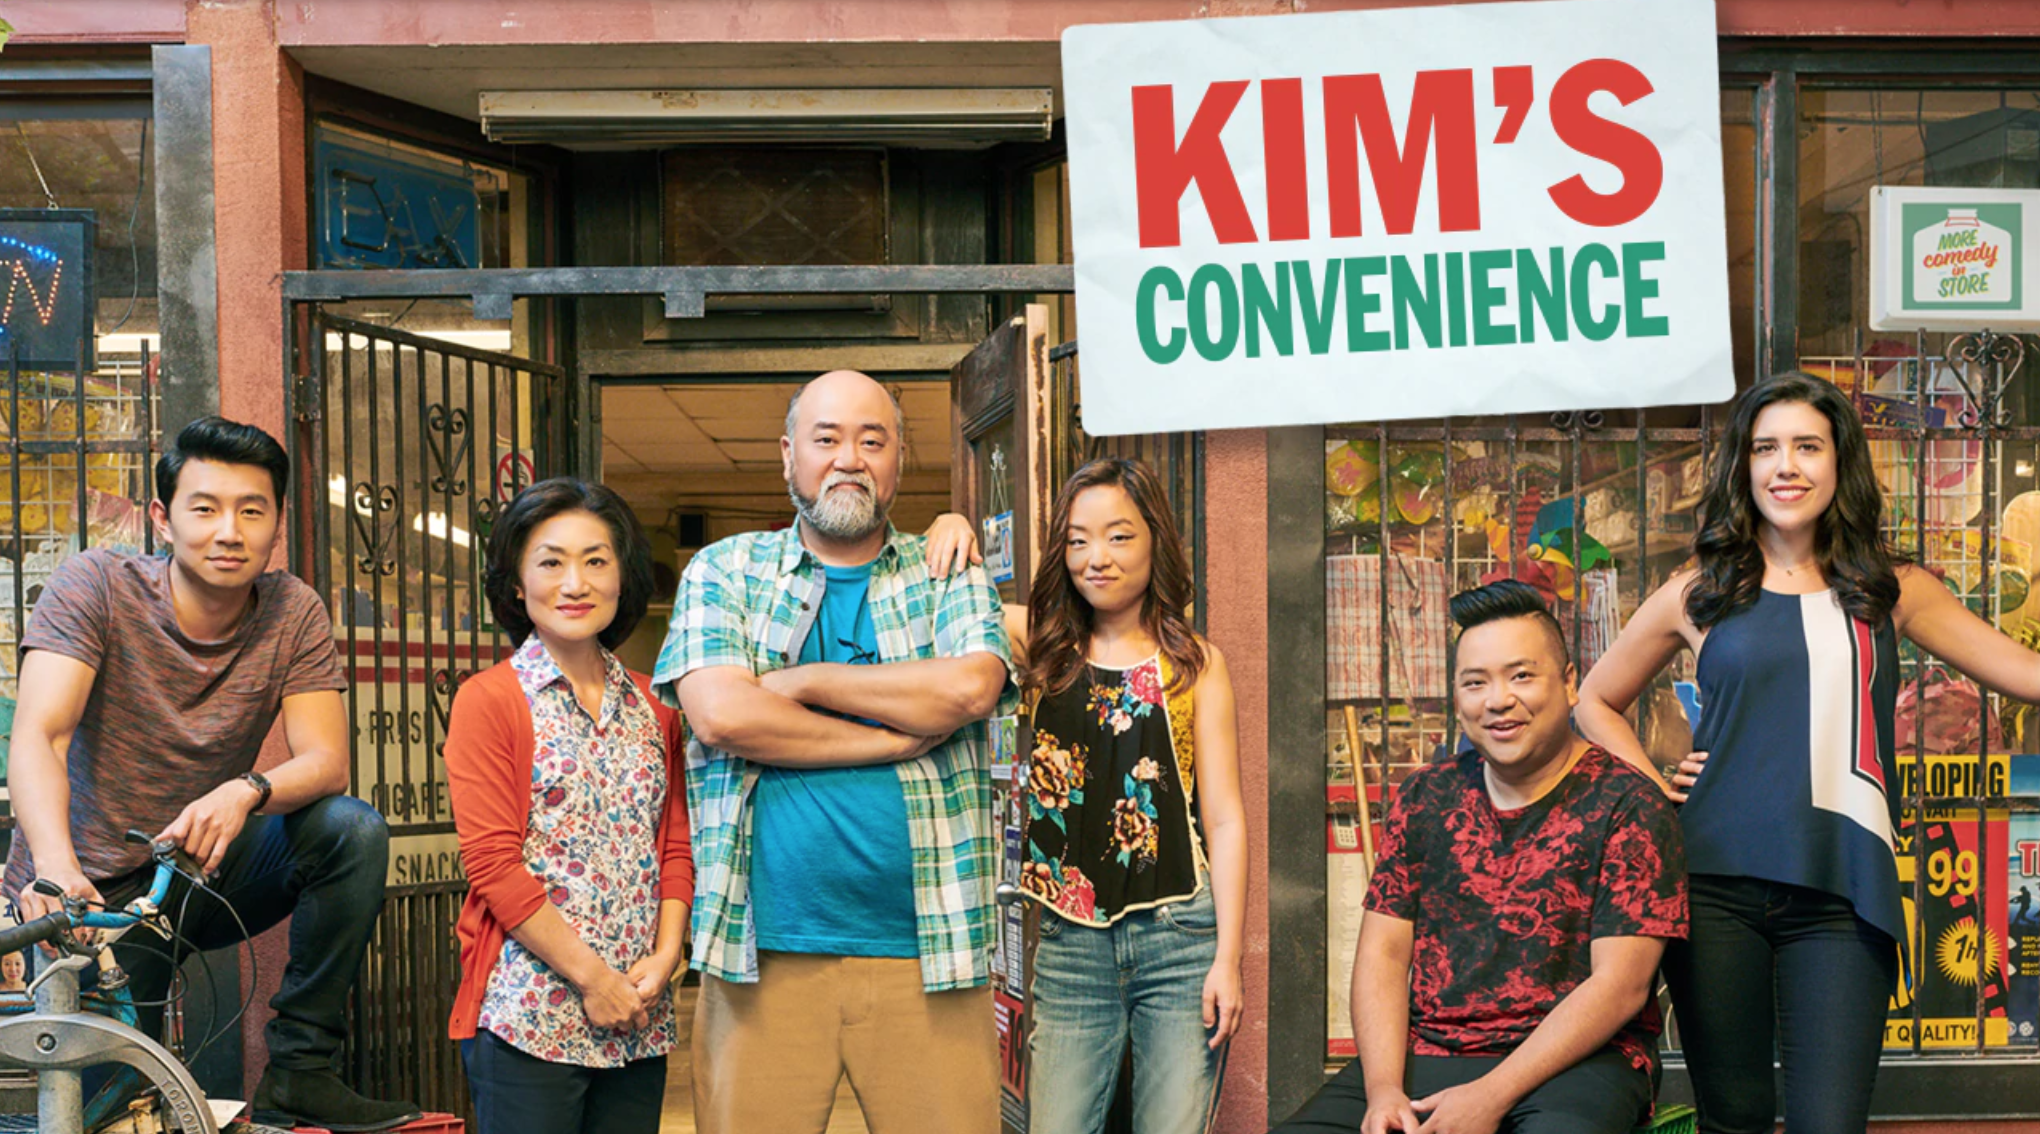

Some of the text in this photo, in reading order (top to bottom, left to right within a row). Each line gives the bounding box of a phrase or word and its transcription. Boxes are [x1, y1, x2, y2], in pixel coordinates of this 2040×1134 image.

[1937, 229, 1978, 251] MORE
[1923, 241, 1999, 269] comedy
[1952, 263, 1967, 277] in
[1938, 272, 1990, 298] STORE
[1927, 850, 1979, 897] 99
[1897, 1024, 1976, 1043] QALITY!
